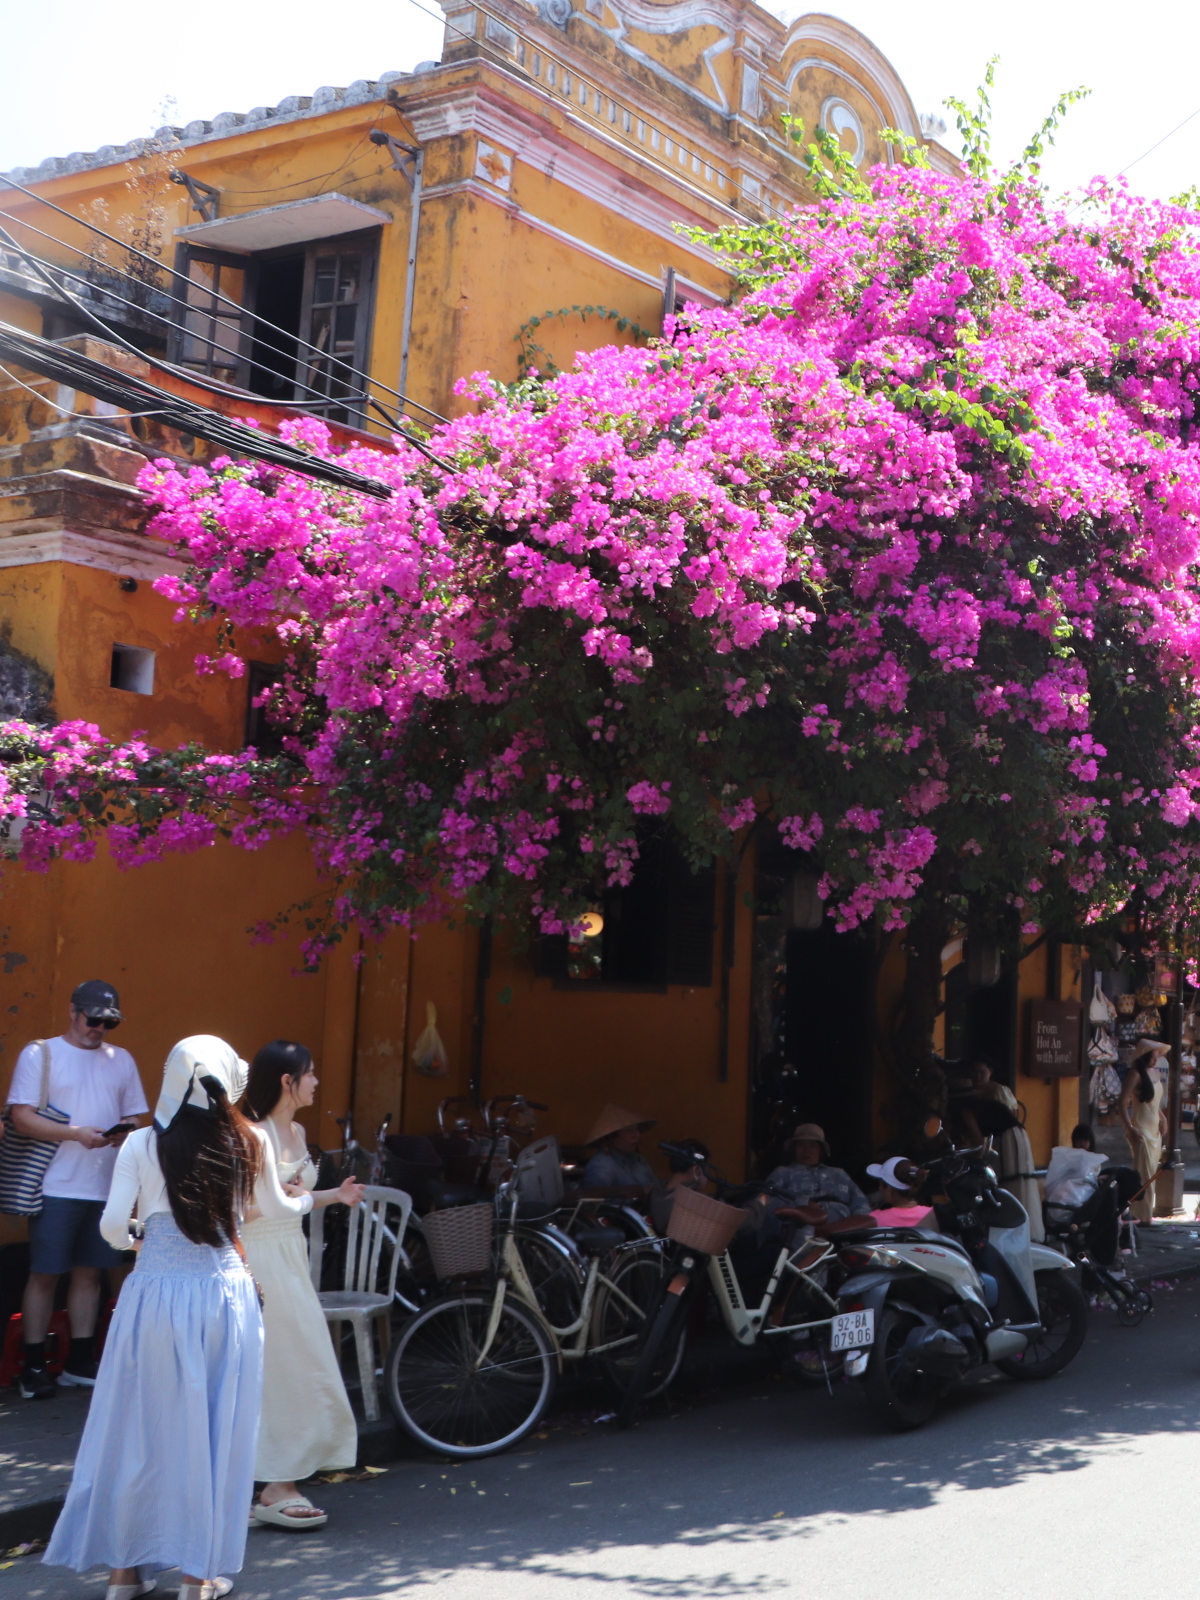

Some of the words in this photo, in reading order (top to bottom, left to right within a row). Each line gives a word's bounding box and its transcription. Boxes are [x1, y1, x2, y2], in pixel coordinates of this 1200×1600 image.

[1037, 1021, 1058, 1034] From
[1036, 1035, 1050, 1049] Hoi
[1051, 1037, 1062, 1049] An
[1036, 1050, 1053, 1064] with
[1054, 1051, 1072, 1064] love!
[838, 1312, 867, 1332] 92-BA
